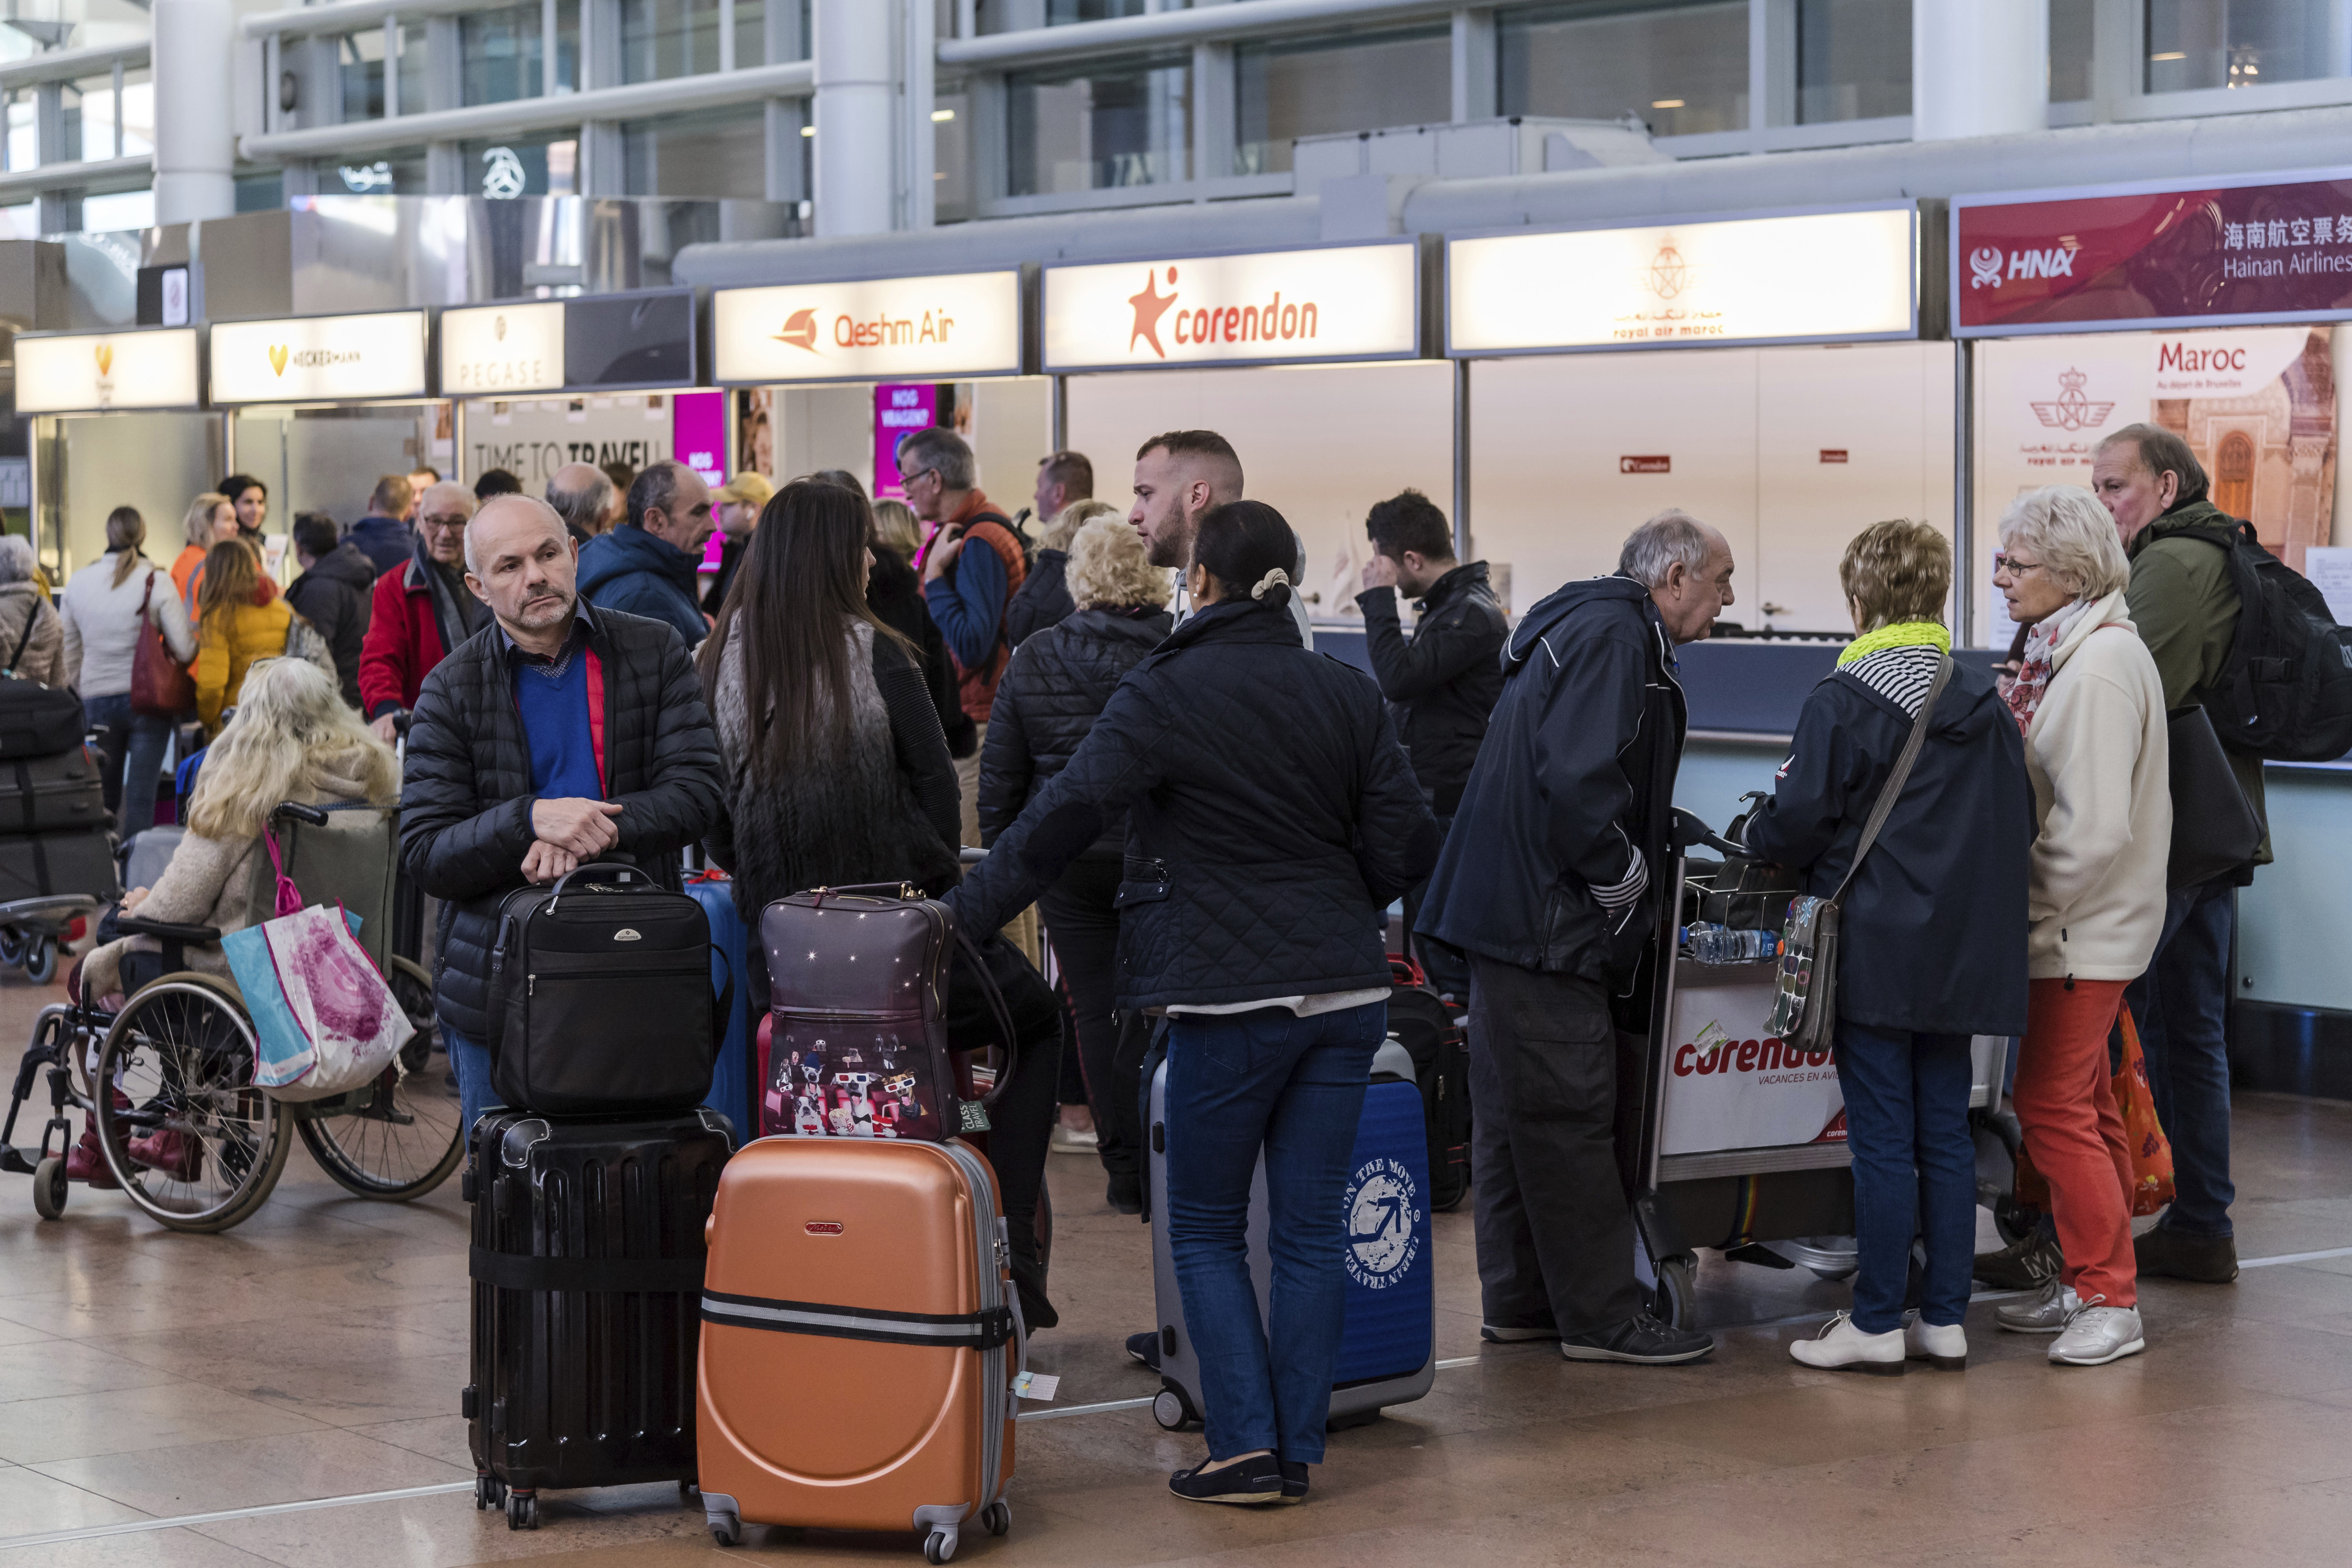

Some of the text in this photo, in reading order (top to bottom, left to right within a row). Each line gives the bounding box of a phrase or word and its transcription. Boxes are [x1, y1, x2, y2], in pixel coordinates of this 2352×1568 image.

[2224, 213, 2352, 251] 海南航空票务
[2224, 250, 2352, 279] Hainan Airlines
[835, 308, 954, 347] Qeshm Air
[1175, 291, 1317, 344] corendon
[1613, 325, 1724, 339] royal air maroc
[2158, 342, 2246, 372] Maroc
[460, 359, 542, 387] PEGASE
[1758, 1074, 1804, 1085] VACANCES
[1807, 1071, 1820, 1082] EN
[960, 1105, 975, 1129] CLASS
[969, 1104, 985, 1128] TRAVEL
[1356, 1158, 1384, 1183] THE
[1389, 1158, 1416, 1197] MOVE
